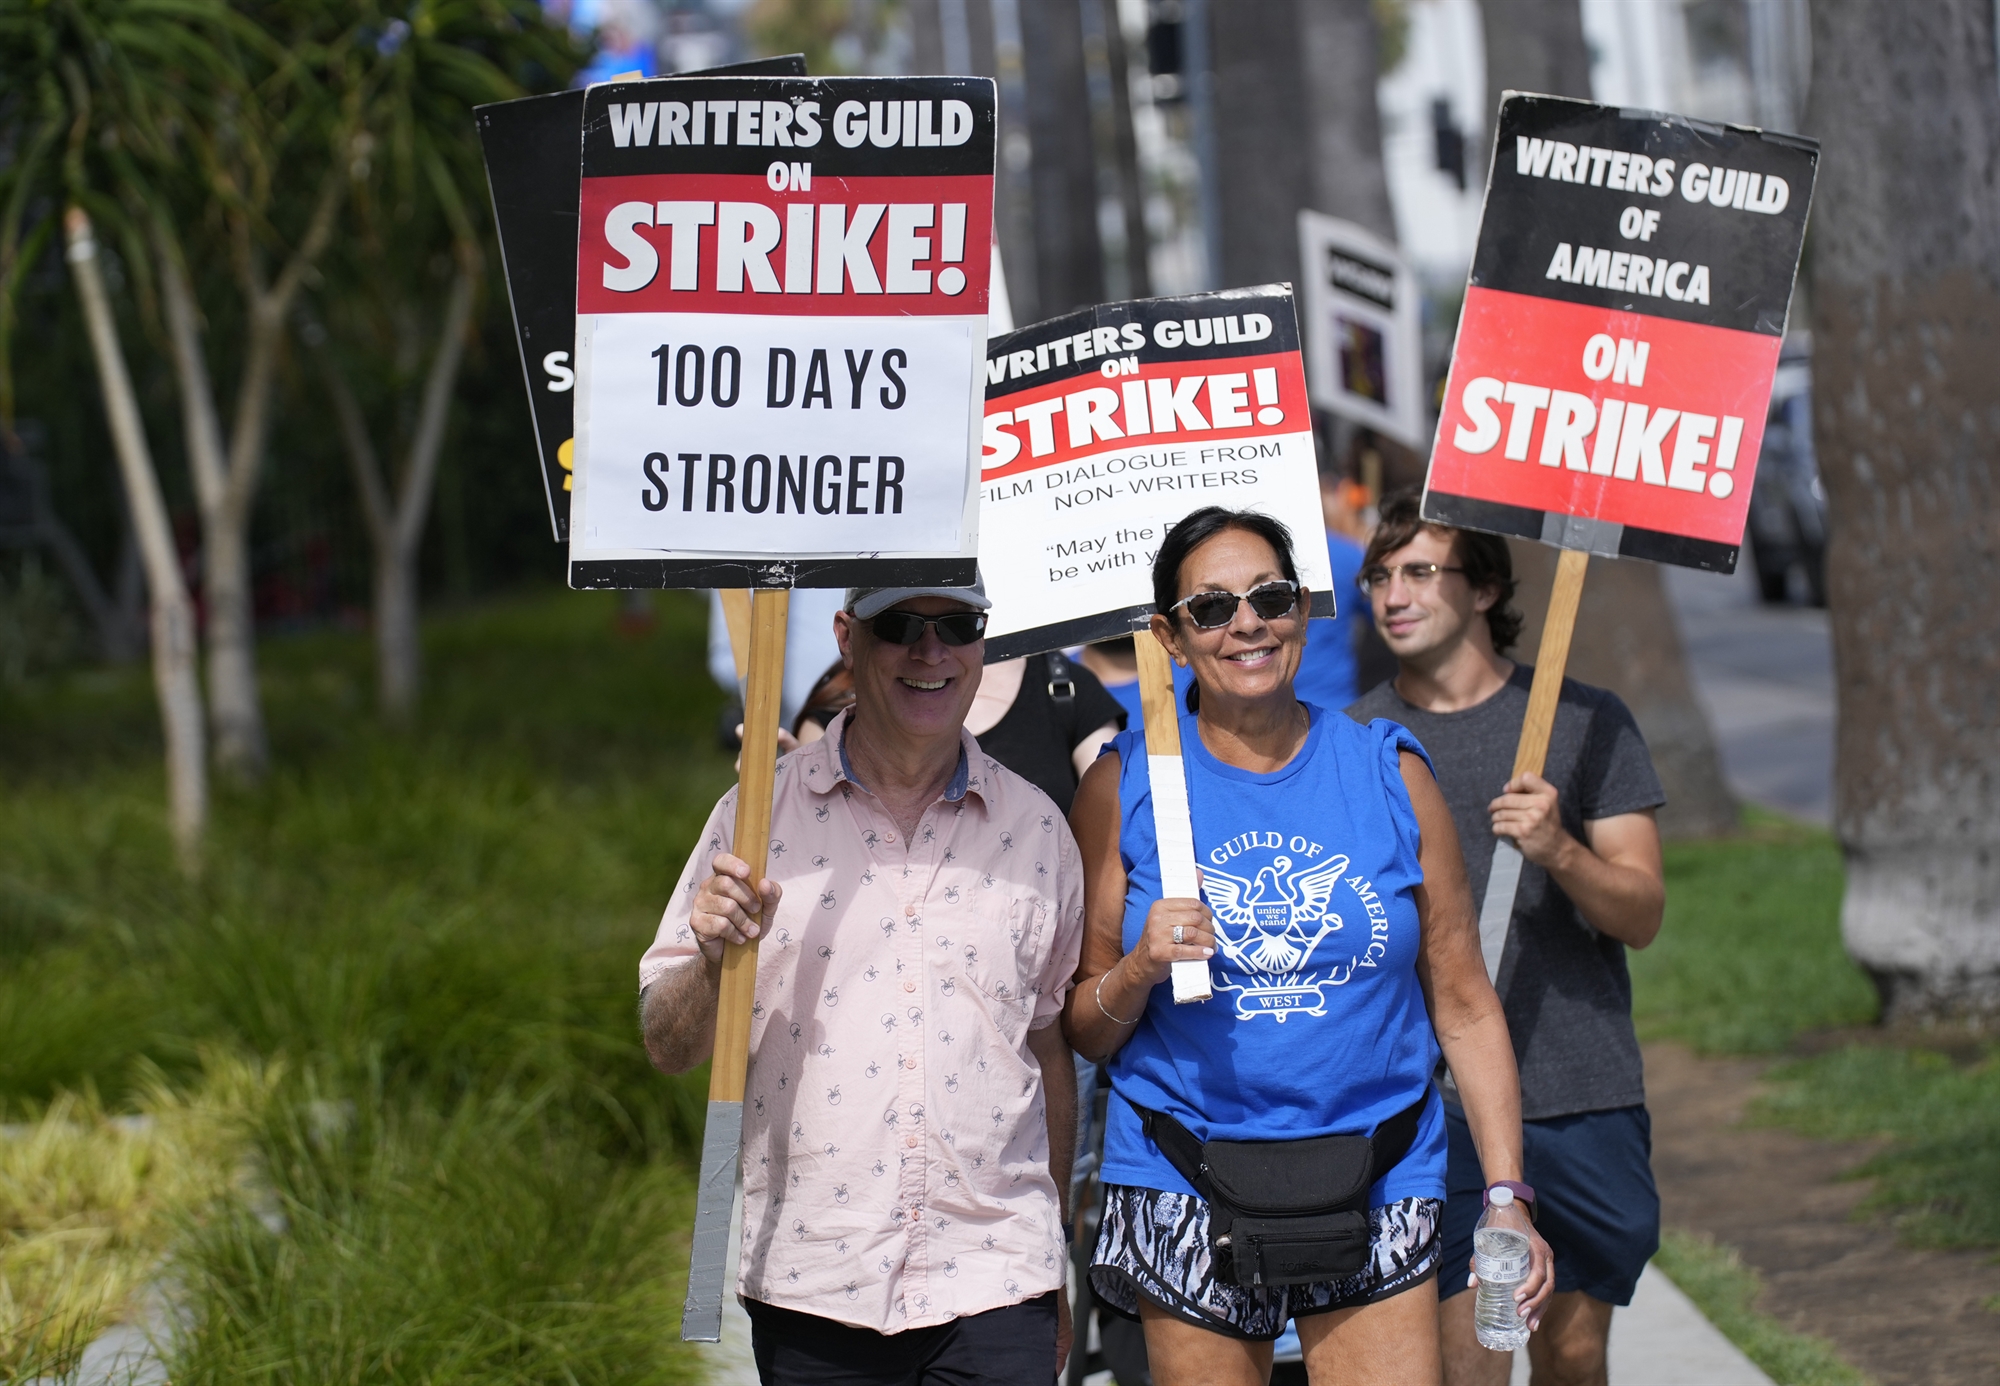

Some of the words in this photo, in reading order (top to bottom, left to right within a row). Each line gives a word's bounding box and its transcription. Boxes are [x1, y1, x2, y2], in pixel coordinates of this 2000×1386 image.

[608, 101, 822, 148] WRITERS
[833, 99, 973, 148] GUILD
[767, 162, 811, 191] ON
[1516, 136, 1675, 198] WRITERS
[1681, 163, 1790, 215] GUILD
[602, 201, 968, 296] STRIKE!
[1619, 206, 1661, 242] OF
[1546, 243, 1710, 306] AMERICA
[986, 322, 1146, 387] WRITERS
[1153, 313, 1272, 348] GUILD
[1100, 355, 1140, 379] ON
[1582, 333, 1651, 388] ON
[651, 344, 741, 408] 100
[767, 347, 907, 410] DAYS
[982, 367, 1285, 470] STRIKE!
[1453, 376, 1745, 500] STRIKE!
[642, 451, 905, 515] STRONGER
[1045, 451, 1188, 489] DIALOGUE
[1200, 442, 1282, 466] FROM
[1115, 525, 1154, 544] the
[1048, 563, 1079, 582] be
[1087, 547, 1136, 574] with
[1210, 831, 1283, 865] GUILD
[1289, 836, 1324, 859] OF
[1344, 875, 1389, 969] AMERICA
[1256, 906, 1287, 915] united
[1259, 918, 1287, 926] stand
[1259, 995, 1302, 1009] WEST
